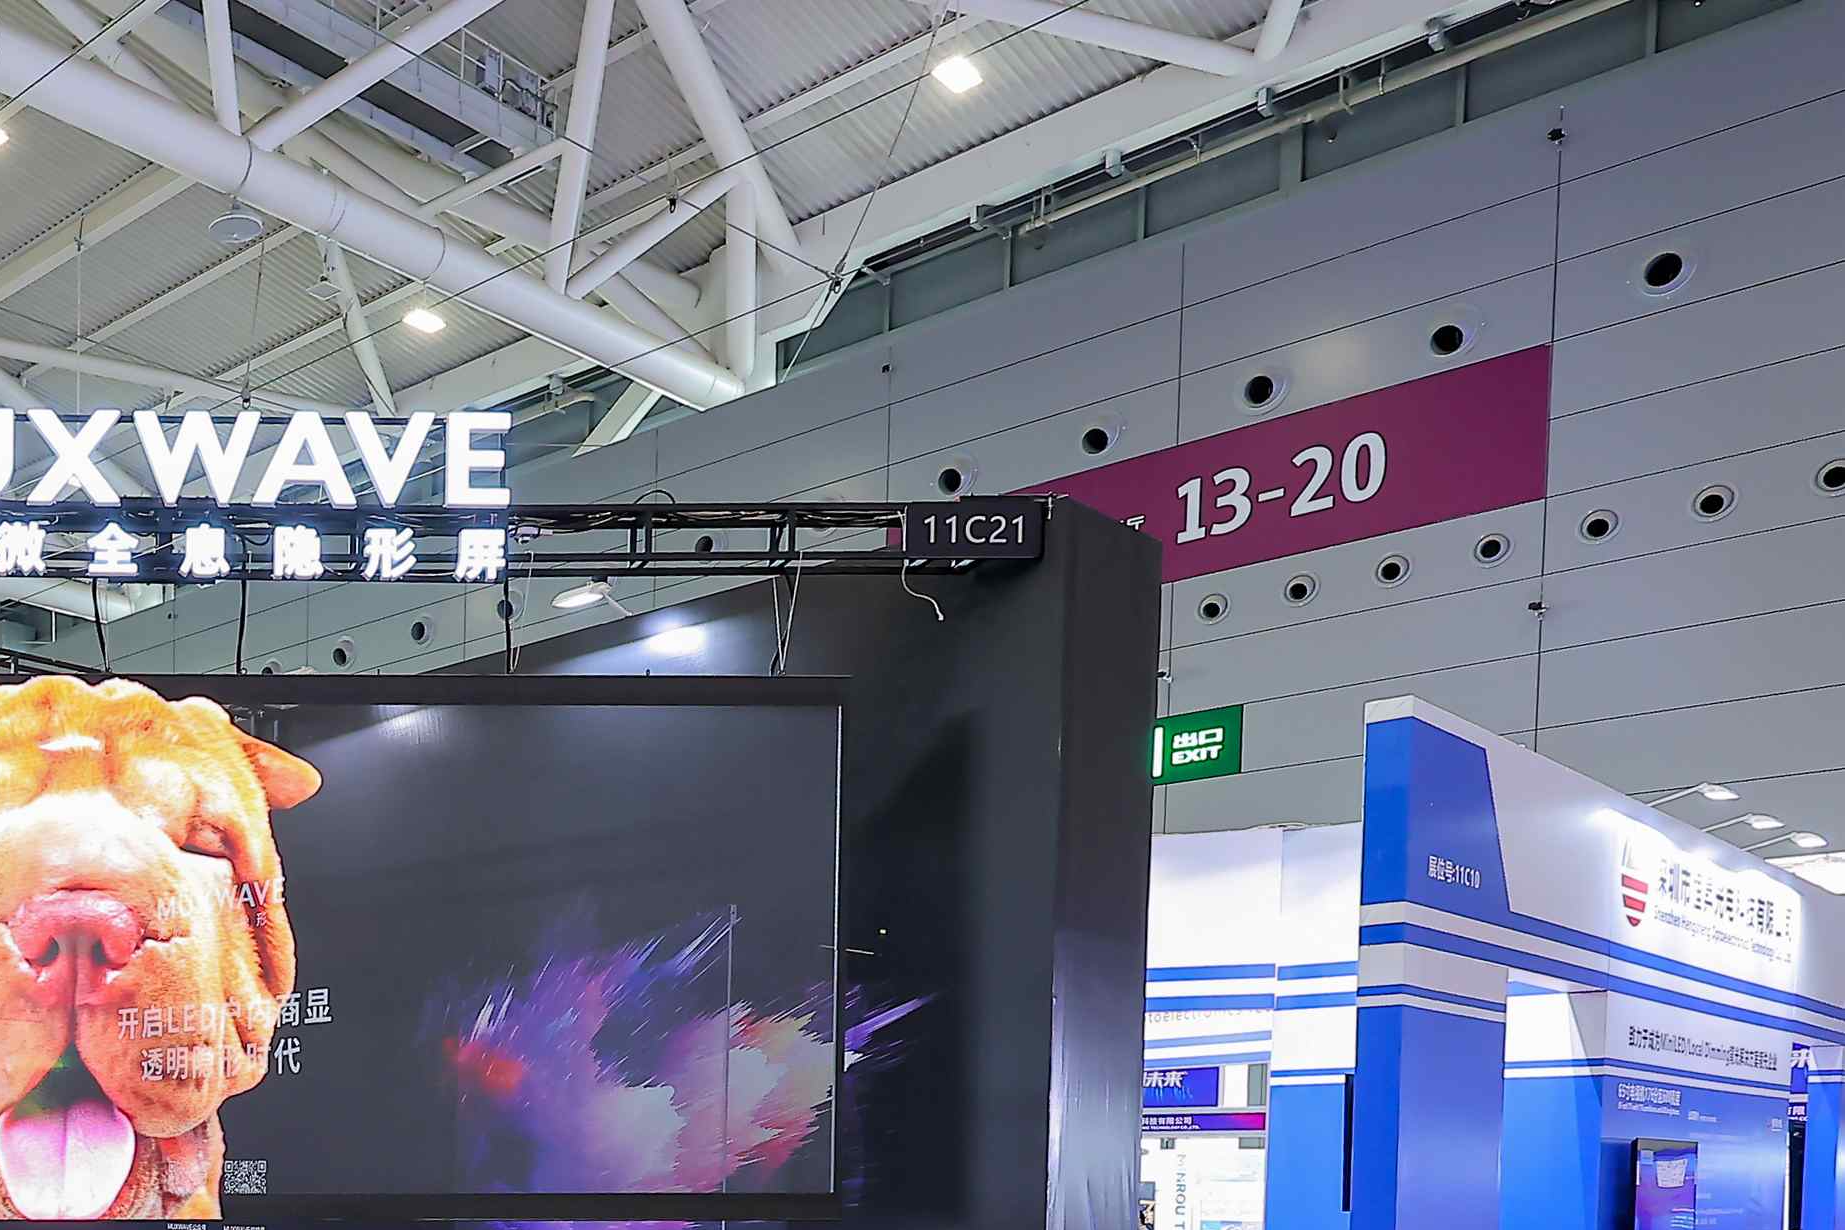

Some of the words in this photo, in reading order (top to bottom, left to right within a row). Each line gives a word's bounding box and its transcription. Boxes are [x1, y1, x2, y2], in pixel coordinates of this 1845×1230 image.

[1176, 431, 1388, 545] 13-20
[923, 515, 1026, 543] 11C21
[1171, 745, 1223, 765] EXIT
[1172, 727, 1224, 749] 出口
[157, 876, 286, 920] MUWAVE
[117, 988, 333, 1040] 开启LED户内商显
[140, 1037, 302, 1082] 透明隐形时代
